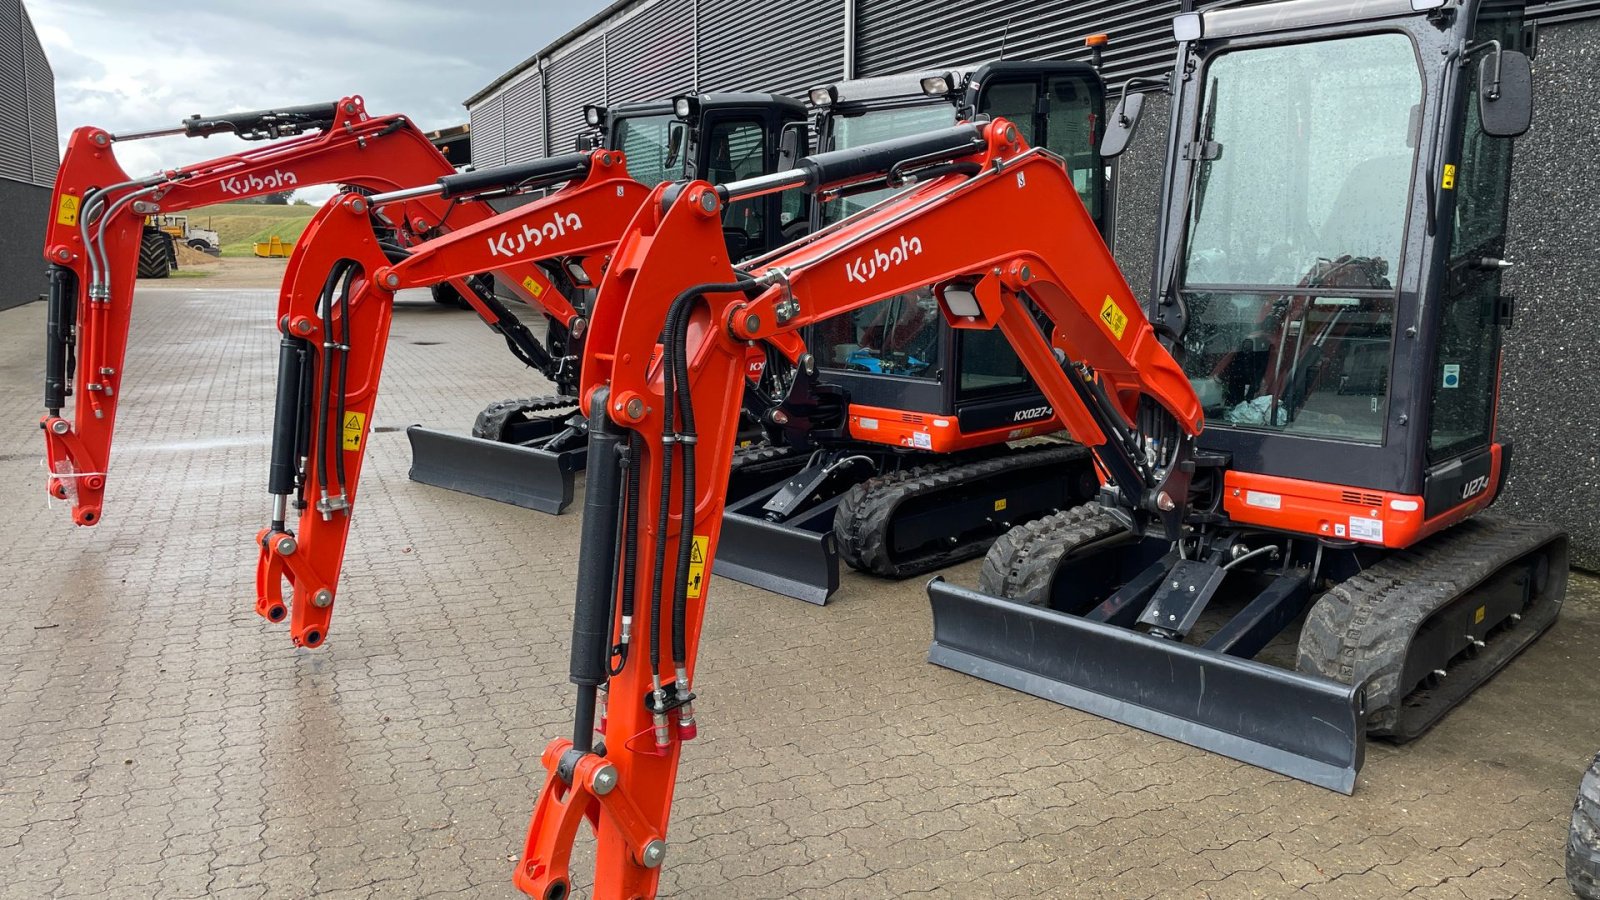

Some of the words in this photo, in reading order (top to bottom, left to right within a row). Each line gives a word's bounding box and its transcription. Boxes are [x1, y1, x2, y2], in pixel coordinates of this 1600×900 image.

[220, 170, 297, 194] Kubota
[487, 212, 582, 257] Kubota
[846, 236, 922, 283] Kubota
